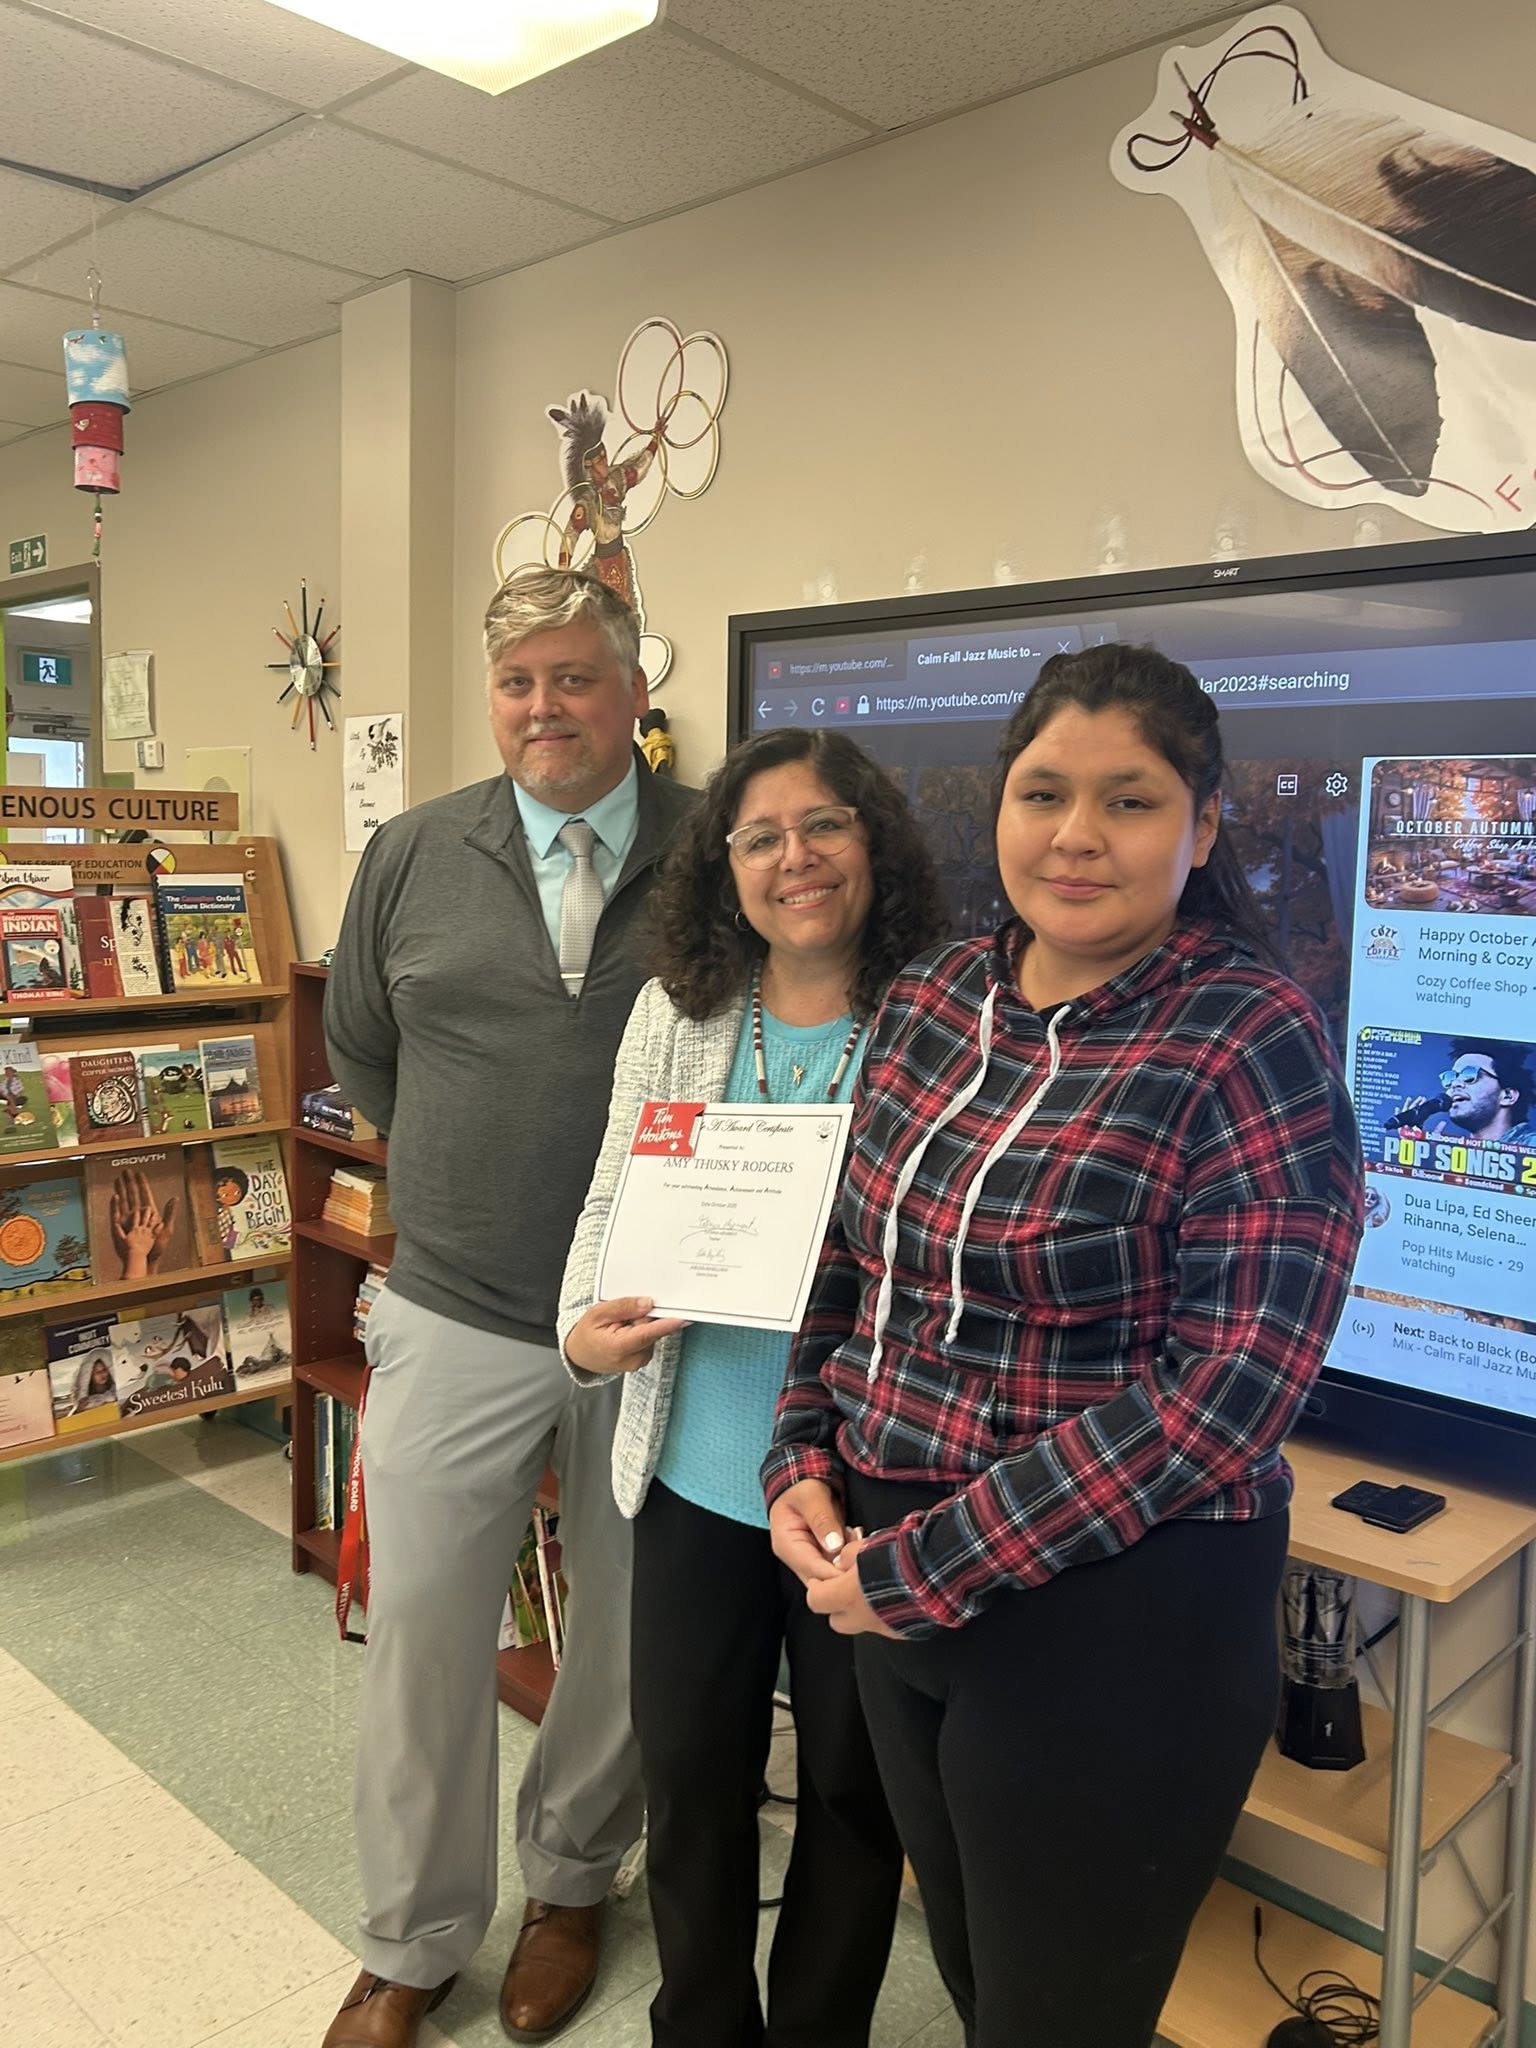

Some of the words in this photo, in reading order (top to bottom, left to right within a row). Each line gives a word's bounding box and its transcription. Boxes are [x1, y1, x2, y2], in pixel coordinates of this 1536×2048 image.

[1213, 567, 1241, 578] SMART
[917, 653, 942, 665] Calm
[943, 652, 961, 664] Fall
[963, 650, 986, 662] Jazz
[987, 648, 1018, 660] Music
[1019, 648, 1031, 658] to
[109, 798, 220, 822] CULTURE
[1396, 820, 1462, 834] OCTOBER
[1470, 821, 1533, 835] AUTUMN
[1453, 839, 1483, 850] Coffee
[1487, 839, 1509, 853] Shop
[70, 860, 84, 869] OF
[85, 859, 142, 869] EDUCATION
[200, 903, 235, 911] Dictionary
[3, 920, 58, 933] INDIAN
[1370, 925, 1398, 938] COZY
[101, 936, 117, 951] Sp
[1420, 927, 1465, 945] Happy
[1469, 930, 1529, 946] October
[1419, 947, 1478, 966] Morning
[1482, 951, 1492, 964] &
[1496, 952, 1533, 969] Cozy
[1416, 975, 1447, 991] Cozy
[1450, 977, 1491, 992] Coffee
[1494, 979, 1527, 995] Shop
[1416, 991, 1472, 1008] watching
[81, 1056, 134, 1068] DAUGHTERS
[652, 1106, 673, 1126] Tim
[638, 1126, 685, 1144] Hortons
[721, 1118, 755, 1132] Award
[756, 1119, 794, 1136] Certificate
[1425, 1131, 1464, 1145] billboard
[1466, 1139, 1481, 1148] HOT
[1501, 1144, 1518, 1153] THIS
[111, 1153, 167, 1167] GROWTH
[256, 1159, 276, 1173] THE
[663, 1158, 691, 1169] AMY
[694, 1158, 740, 1171] THUSKY
[742, 1160, 795, 1174] RODGERS
[1383, 1136, 1430, 1167] POP
[1435, 1144, 1517, 1181] SONGS
[251, 1172, 277, 1192] DAY
[251, 1190, 282, 1210] YOU
[1404, 1193, 1431, 1209] Dua
[1436, 1199, 1468, 1218] Lipa,
[1473, 1205, 1491, 1220] Ed
[1403, 1212, 1463, 1237] Rihanna,
[1402, 1240, 1425, 1256] Pop
[1429, 1244, 1453, 1260] Hits
[1456, 1250, 1494, 1267] Music
[1507, 1259, 1524, 1273] 29
[1401, 1257, 1456, 1277] watching
[1393, 1321, 1425, 1339] Next:
[1428, 1330, 1458, 1347] Back
[1462, 1338, 1474, 1350] to
[1477, 1341, 1511, 1359] Black
[1393, 1337, 1414, 1352] Mix
[1424, 1344, 1455, 1361] Calm
[1458, 1352, 1480, 1367] Fall
[1482, 1359, 1513, 1375] Jazz
[129, 1386, 189, 1413] Sweetest
[192, 1375, 225, 1399] Kulu
[349, 1480, 359, 1512] BOARD
